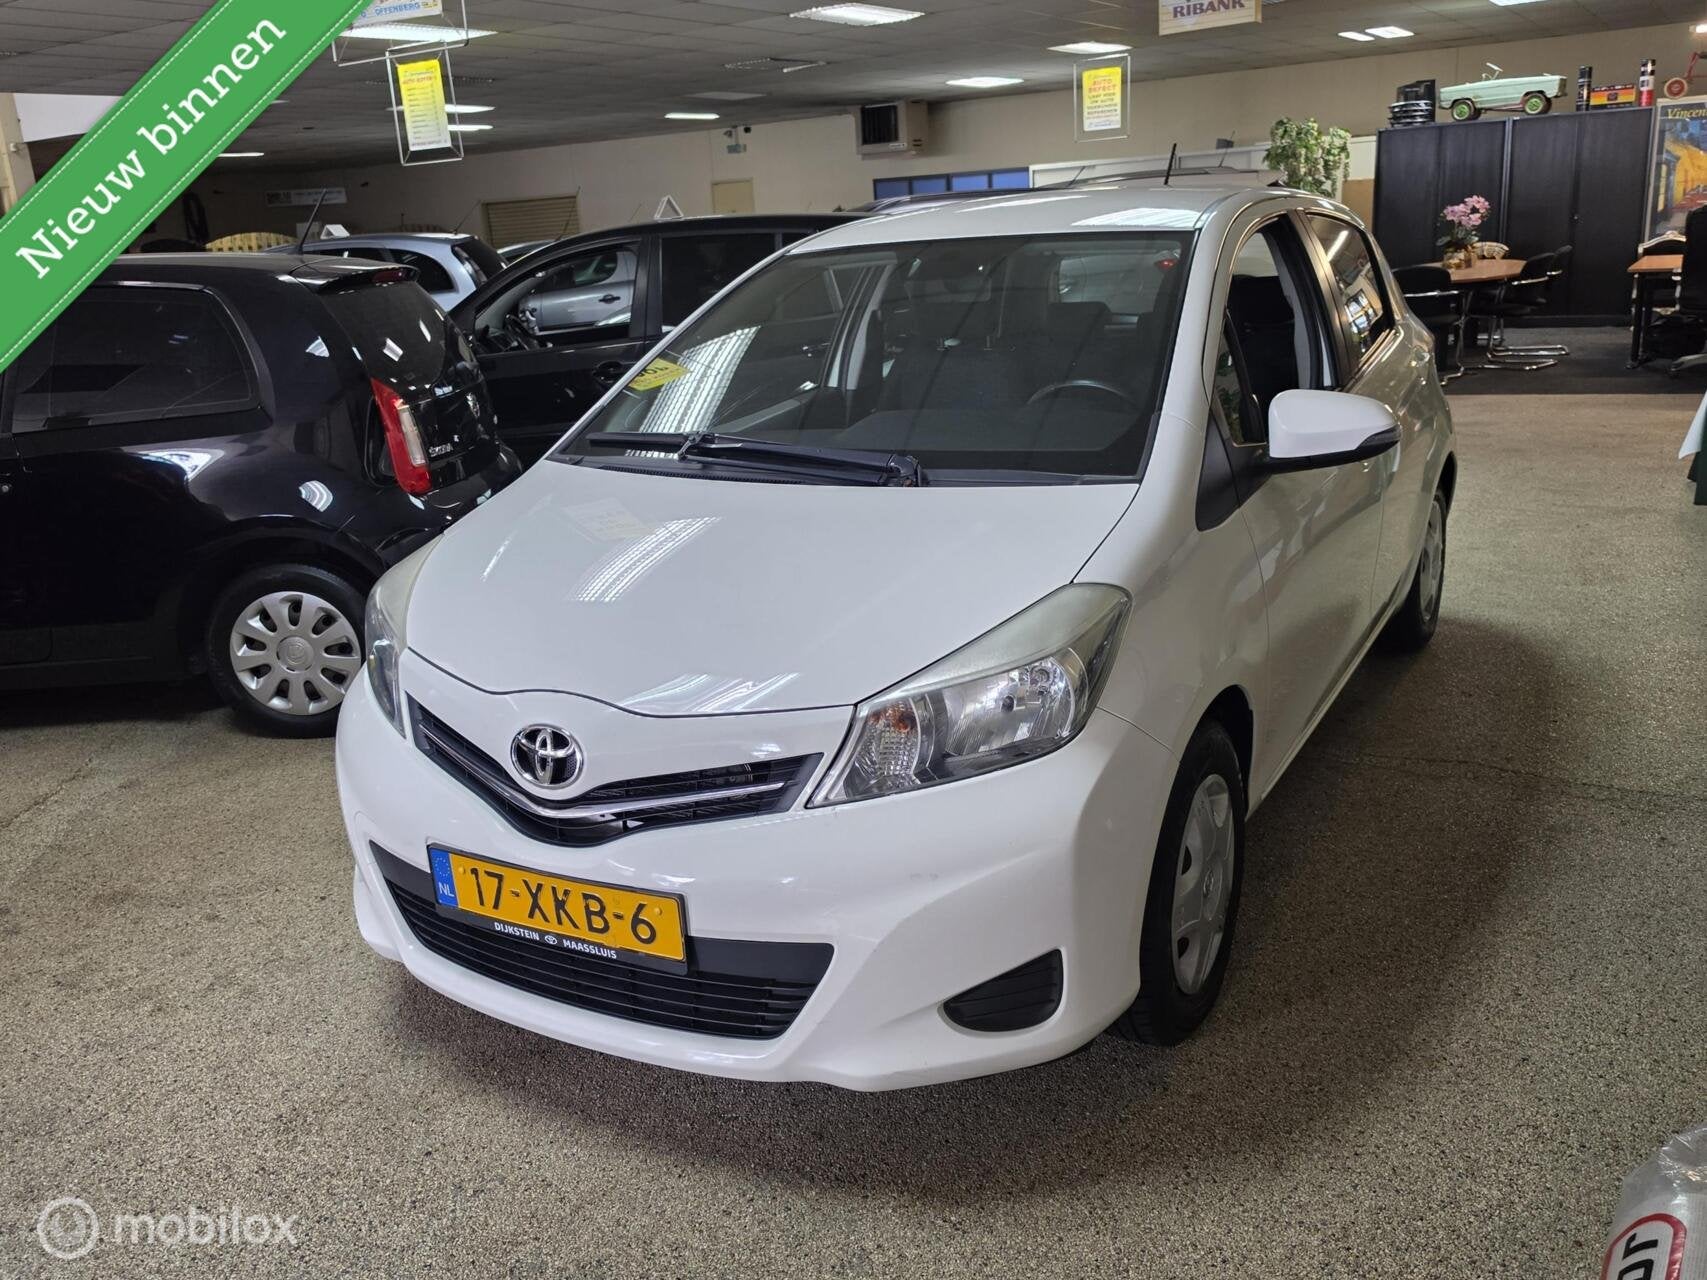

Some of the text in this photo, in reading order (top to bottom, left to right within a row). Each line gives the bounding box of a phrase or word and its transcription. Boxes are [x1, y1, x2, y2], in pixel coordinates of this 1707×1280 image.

[1172, 0, 1245, 18] RIBANK
[438, 882, 455, 898] NL
[469, 867, 657, 945] 17-XKB-6
[493, 921, 617, 960] DIJKSTEIN MAASSLUIS
